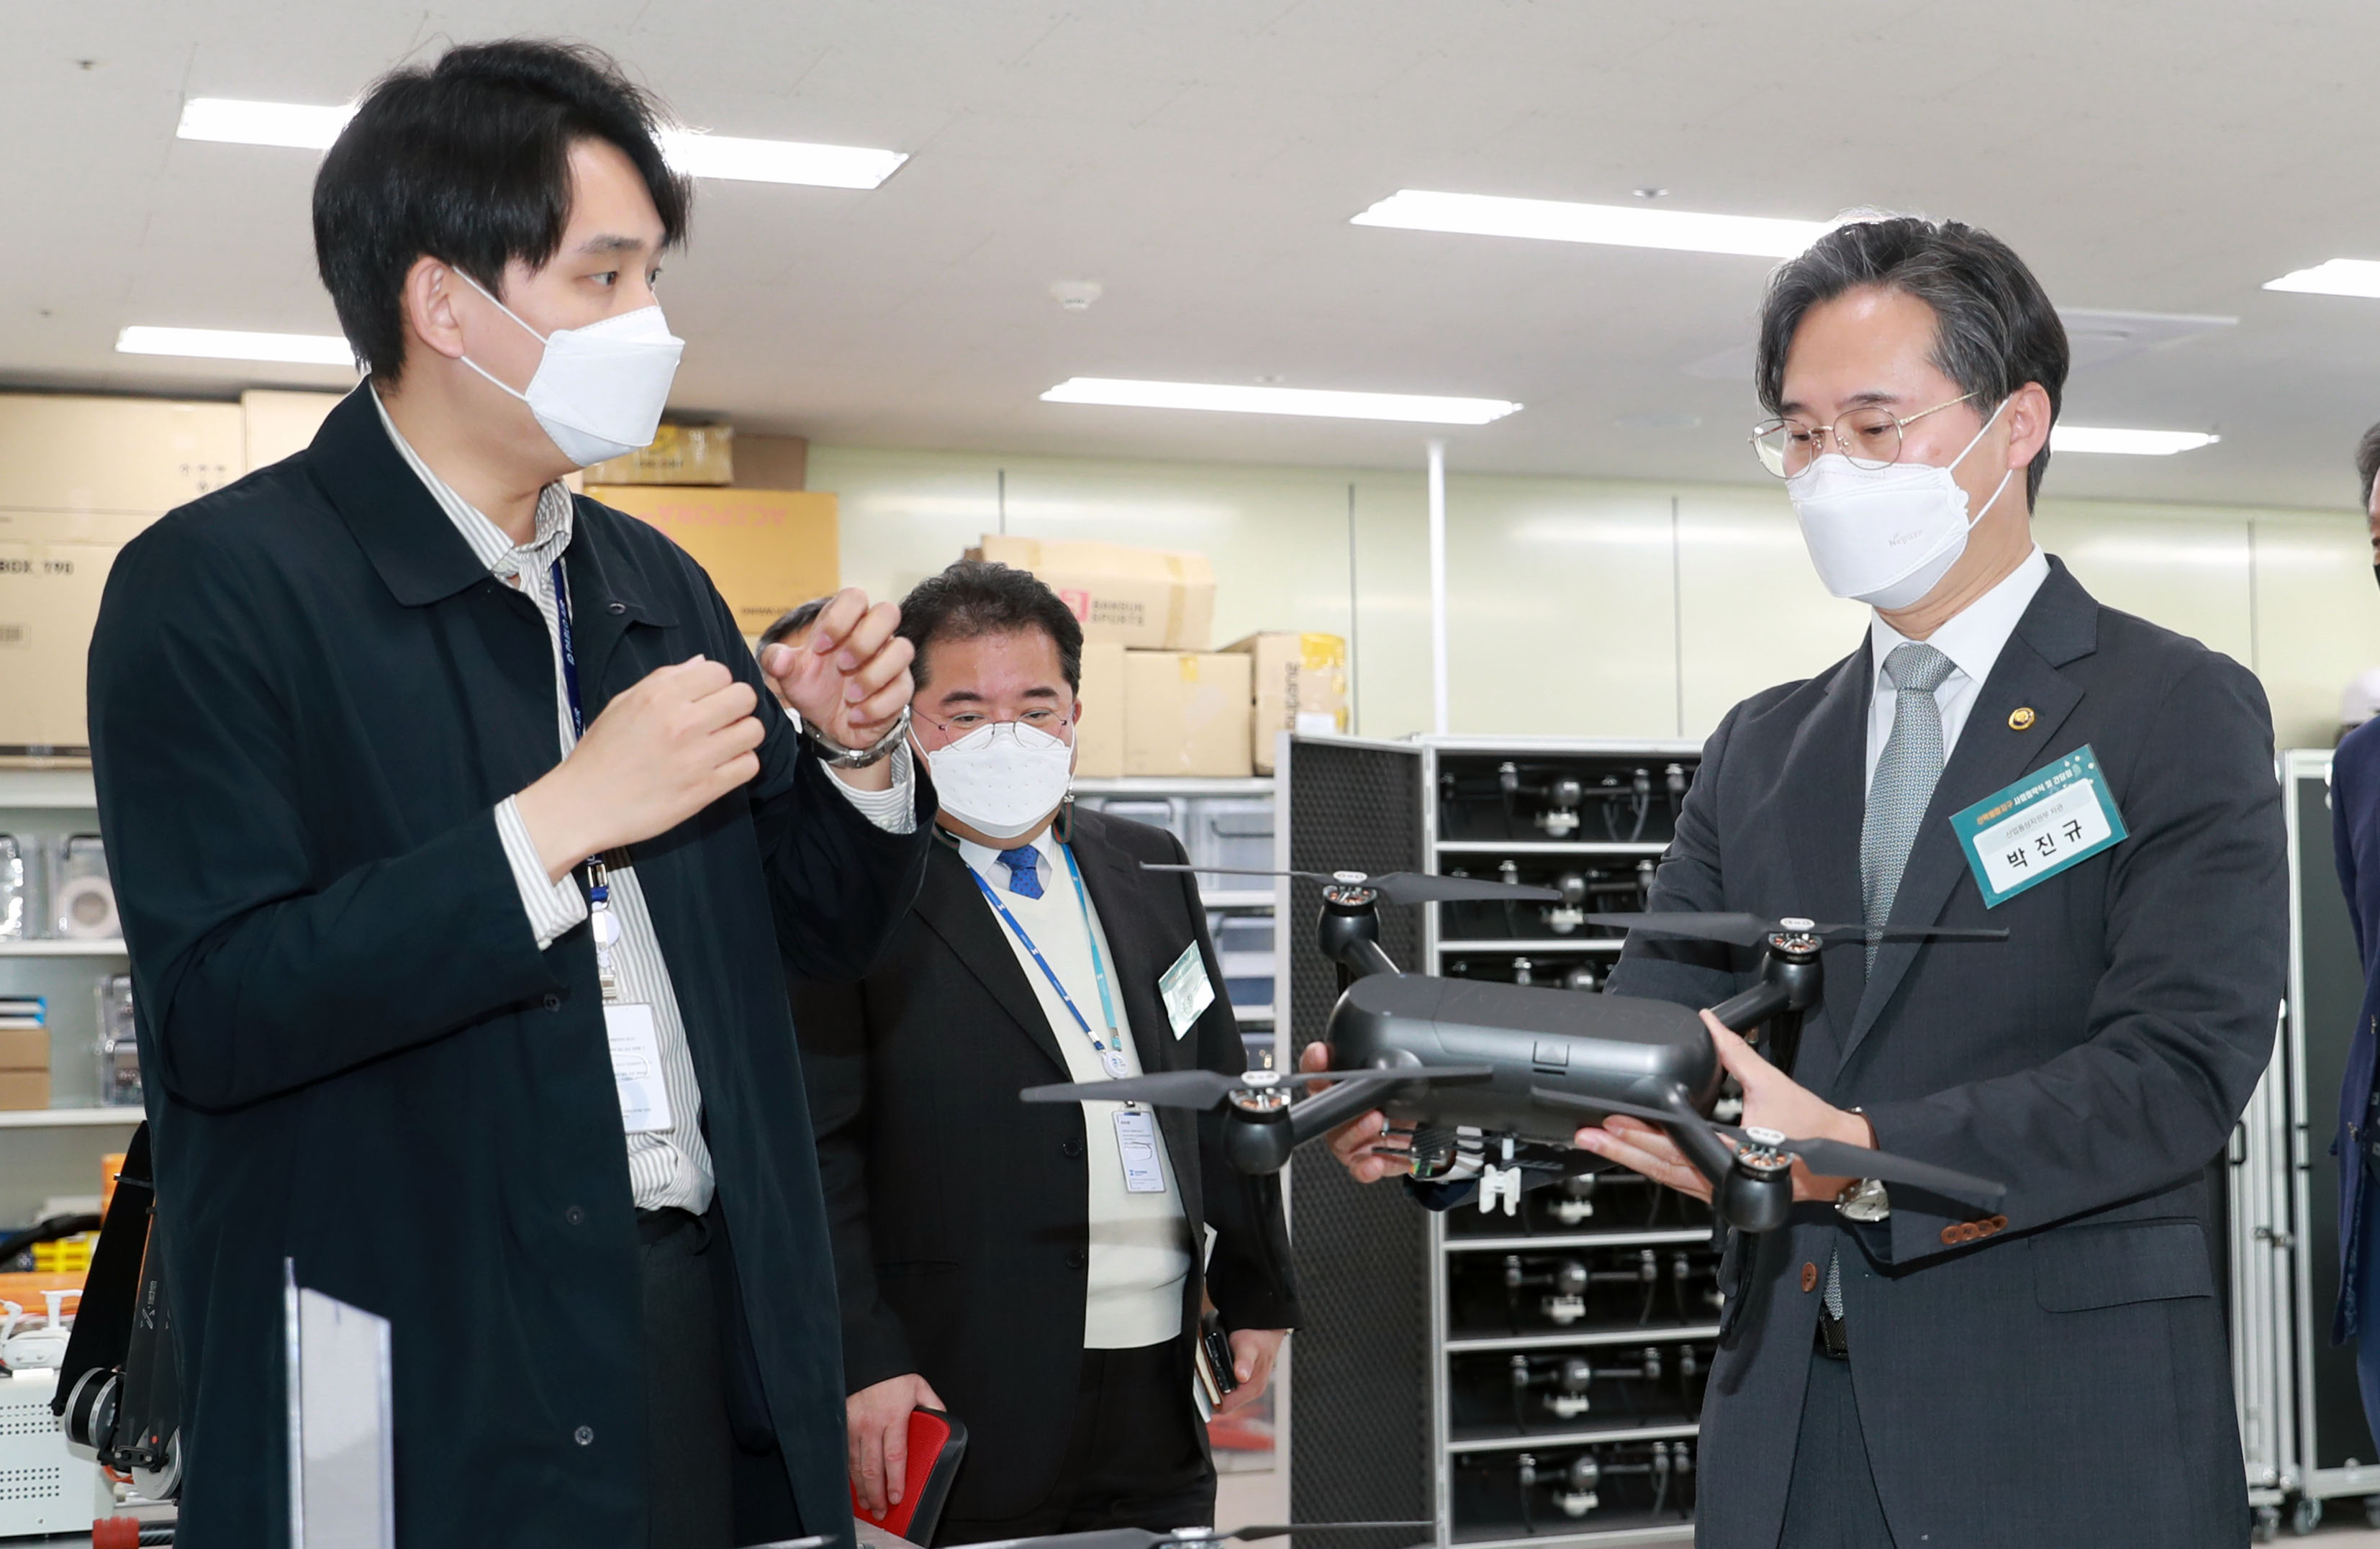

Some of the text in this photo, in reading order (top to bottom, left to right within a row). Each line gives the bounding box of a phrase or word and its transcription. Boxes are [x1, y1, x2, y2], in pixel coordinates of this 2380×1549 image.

[559, 599, 573, 653] PABLO AIR
[2006, 812, 2049, 838] 산업통상자원부
